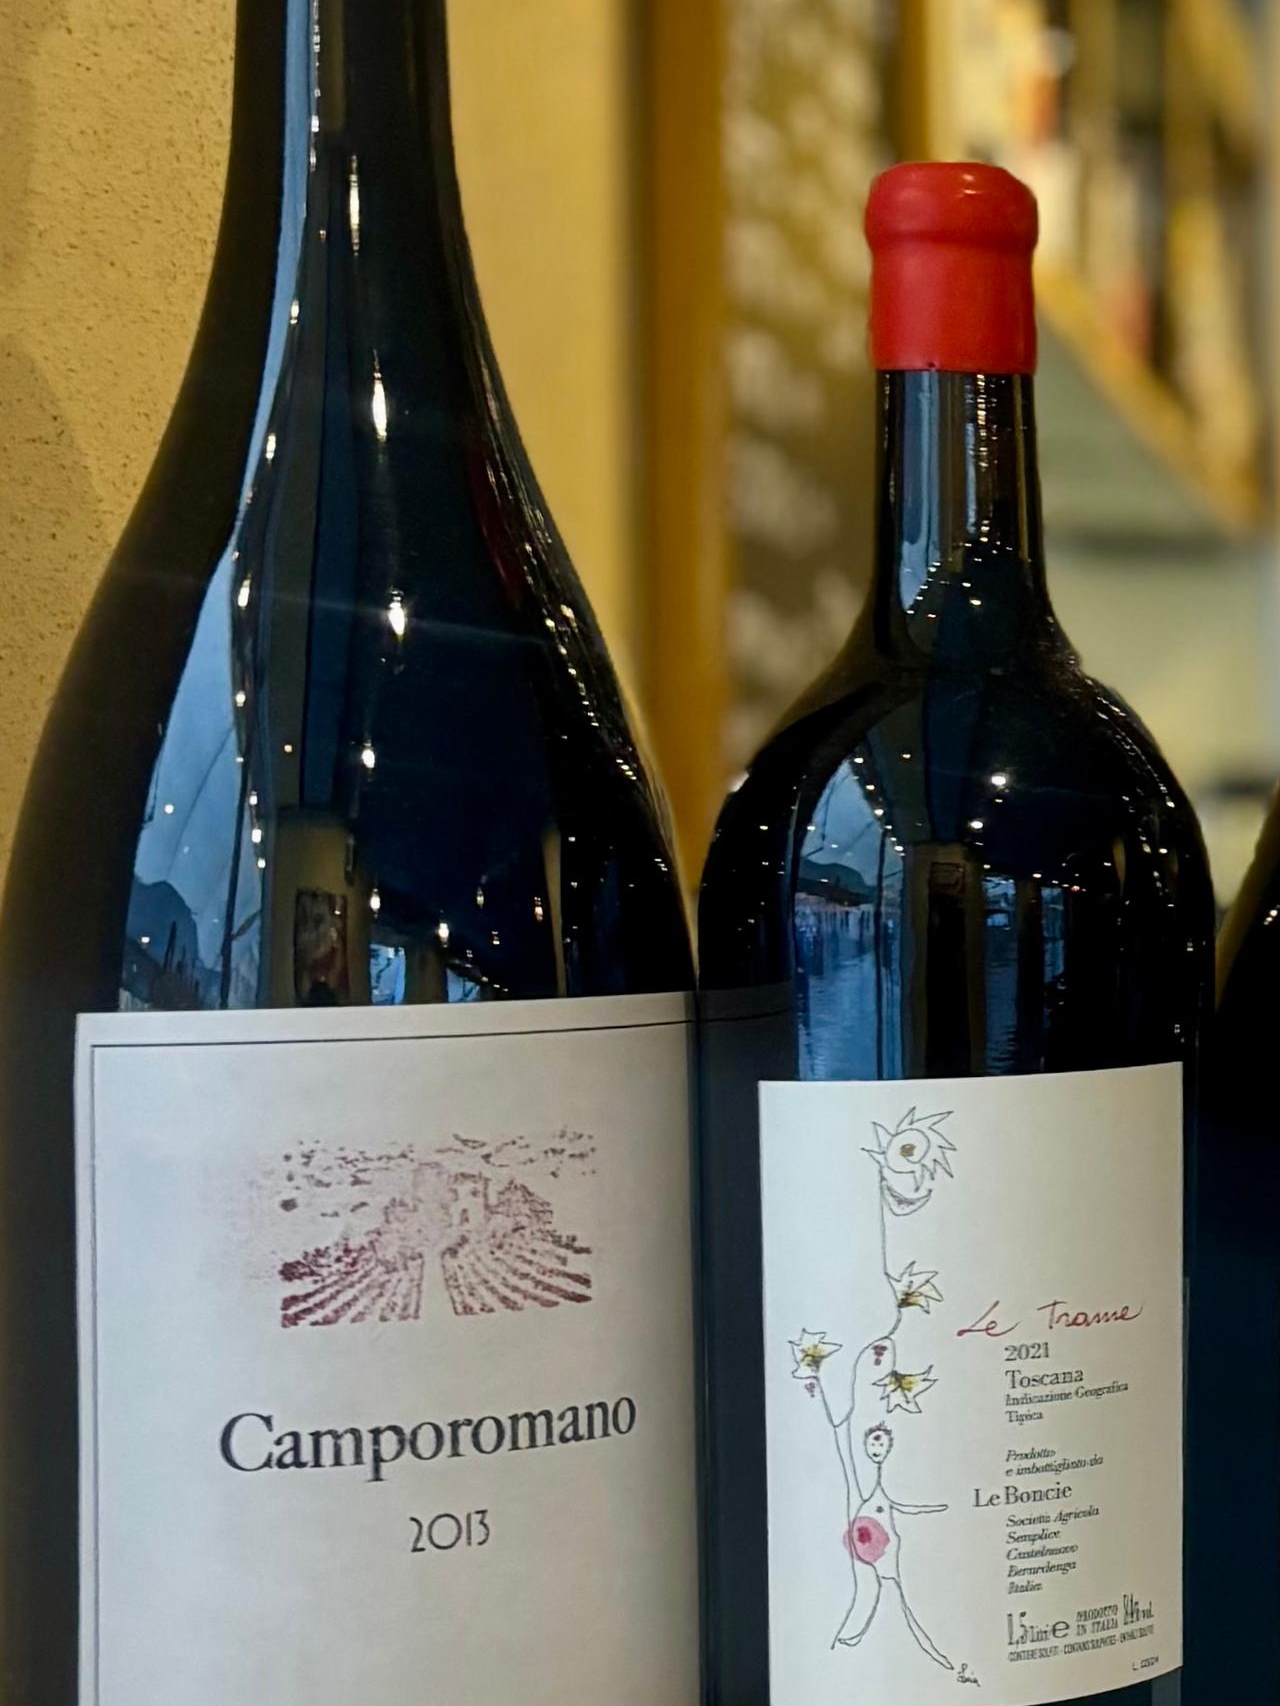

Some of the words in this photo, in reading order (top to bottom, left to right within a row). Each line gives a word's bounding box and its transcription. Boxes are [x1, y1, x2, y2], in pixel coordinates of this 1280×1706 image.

[956, 1300, 1020, 1337] Le
[1037, 1299, 1146, 1329] Trame
[1004, 1342, 1050, 1362] 2021
[1005, 1369, 1085, 1390] Toscana
[1005, 1390, 1074, 1407] Indicazione
[1075, 1381, 1130, 1400] Geografica
[1005, 1409, 1044, 1426] Tipica
[220, 1396, 637, 1483] Camporomano
[973, 1489, 1001, 1508] Le
[1004, 1482, 1073, 1505] Boncie
[409, 1510, 491, 1553] 2013
